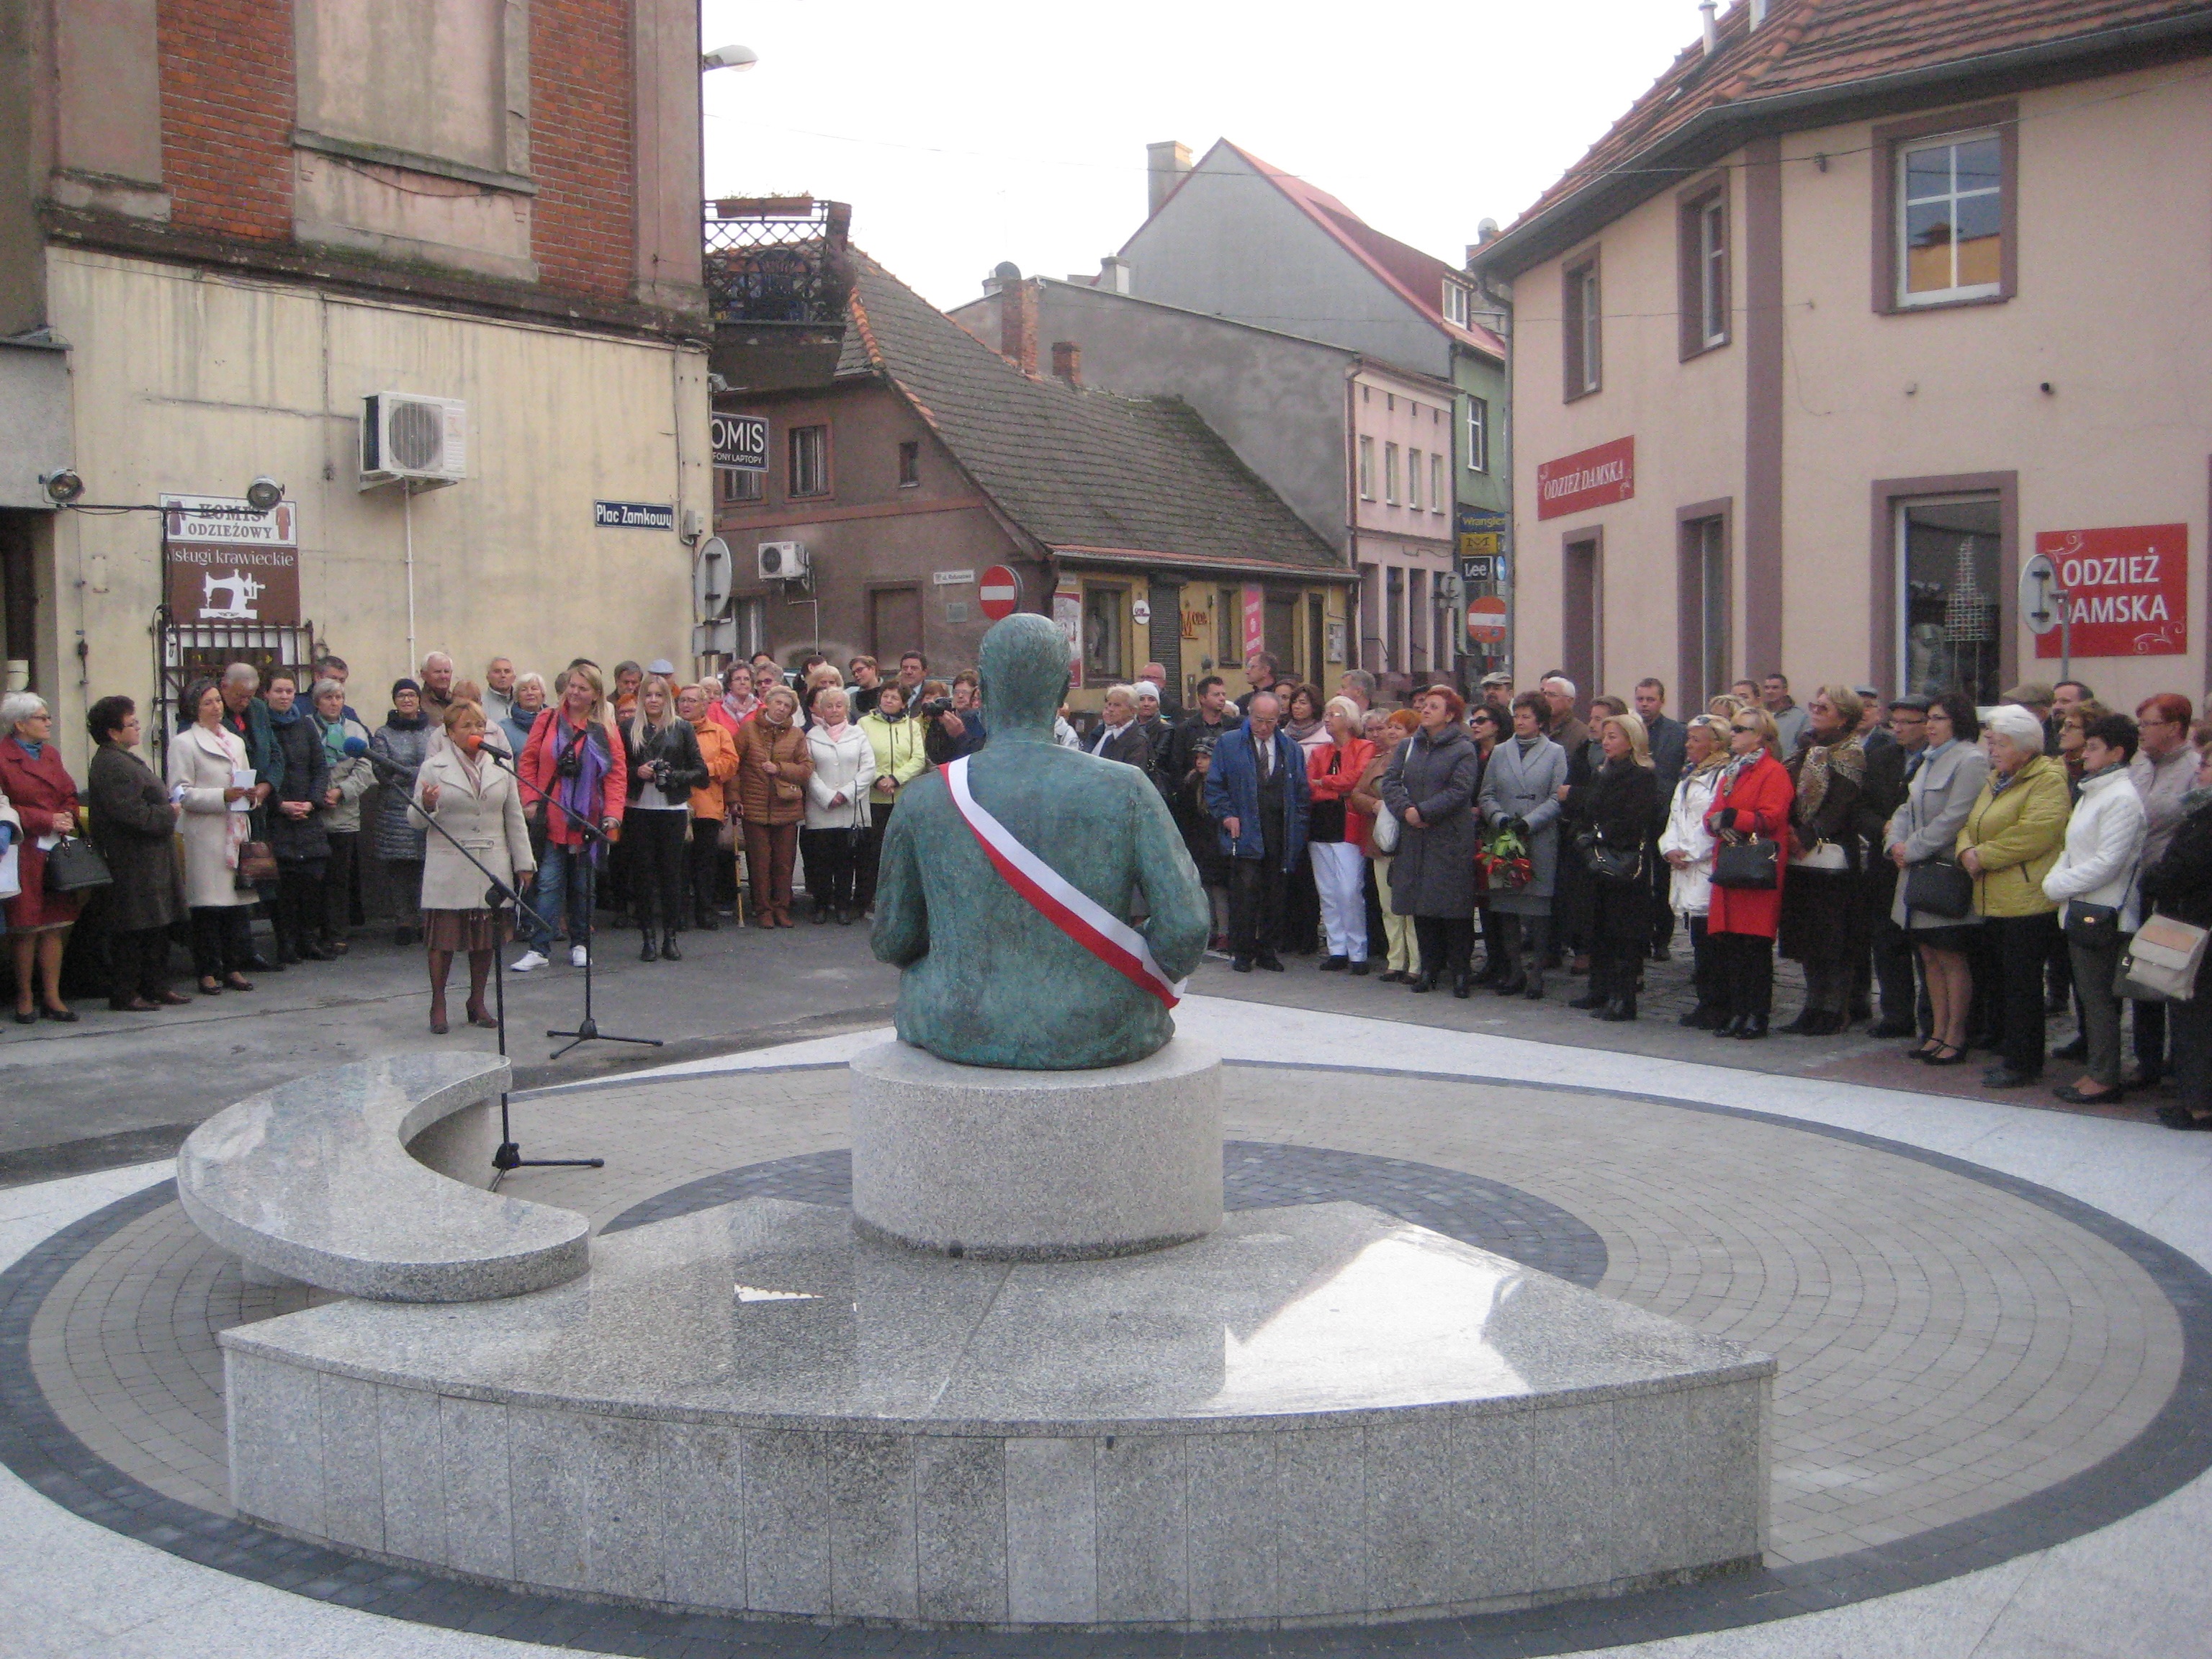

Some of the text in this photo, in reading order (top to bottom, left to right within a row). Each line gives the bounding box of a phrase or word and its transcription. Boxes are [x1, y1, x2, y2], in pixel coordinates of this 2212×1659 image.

[732, 454, 762, 464] LAPTOPY
[1544, 458, 1624, 500] ODZIEŻ DAMSKA
[596, 504, 672, 529] Plac Zamkowy
[188, 522, 272, 539] ODZIEŻOWY
[216, 549, 294, 566] krawieckie
[1464, 562, 1488, 577] Lee
[2062, 547, 2160, 587] ODZIEŻ
